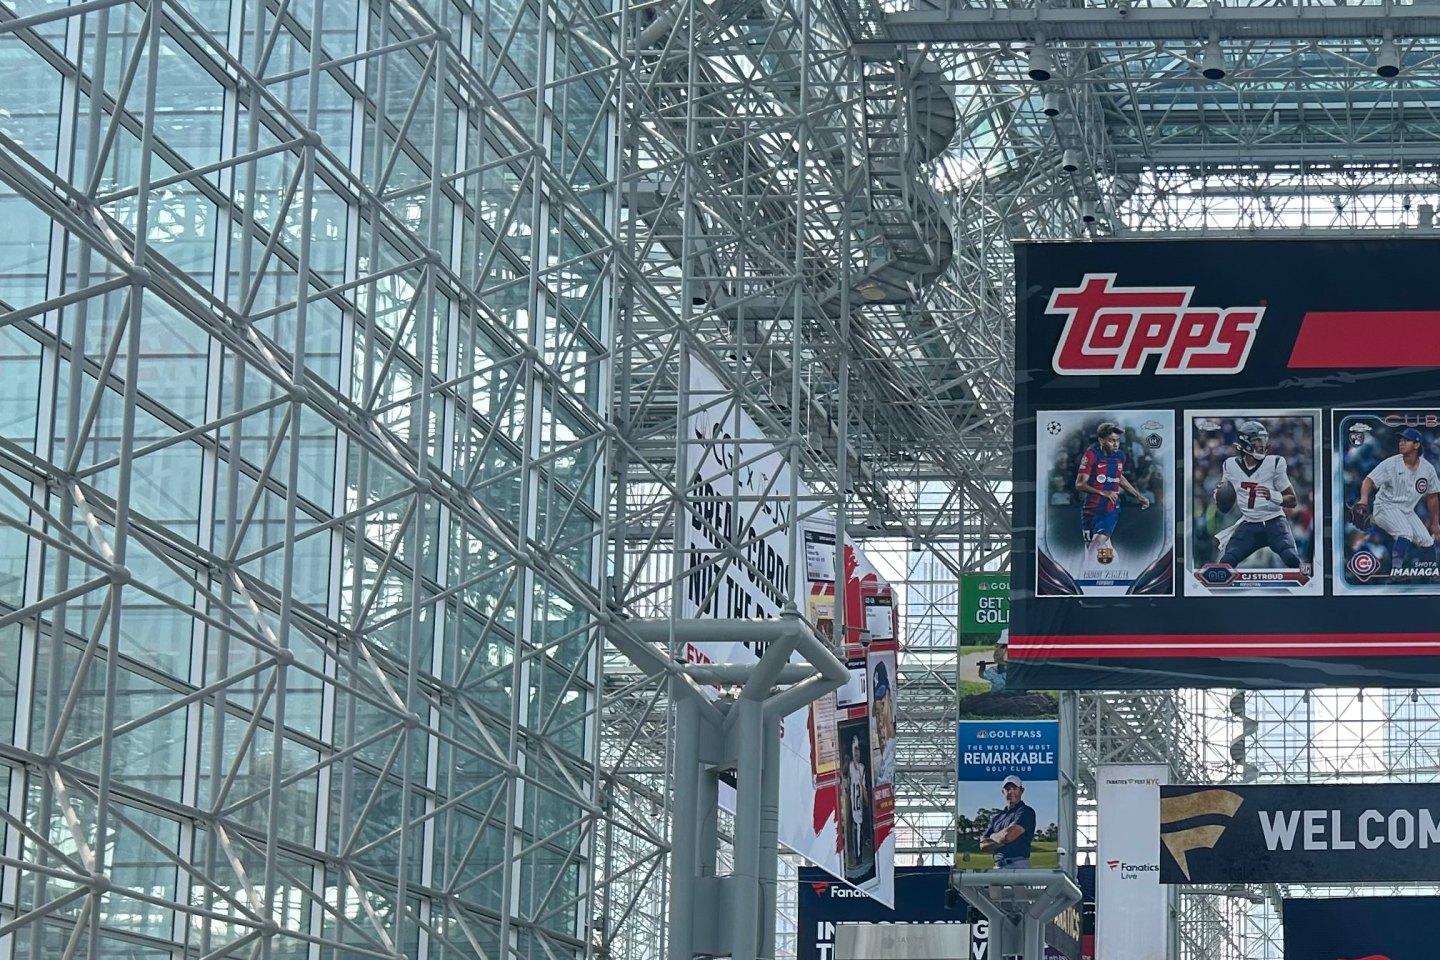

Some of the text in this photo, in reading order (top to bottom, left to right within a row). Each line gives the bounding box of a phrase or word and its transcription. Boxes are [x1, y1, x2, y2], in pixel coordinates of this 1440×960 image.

[1240, 481, 1259, 510] 7
[1390, 567, 1440, 577] IMANAGA
[979, 597, 1004, 609] GET
[989, 730, 1042, 739] GOLFPASS
[964, 752, 1054, 765] REMARKABLE
[1146, 778, 1160, 786] NYC
[1121, 862, 1160, 872] Fanatics
